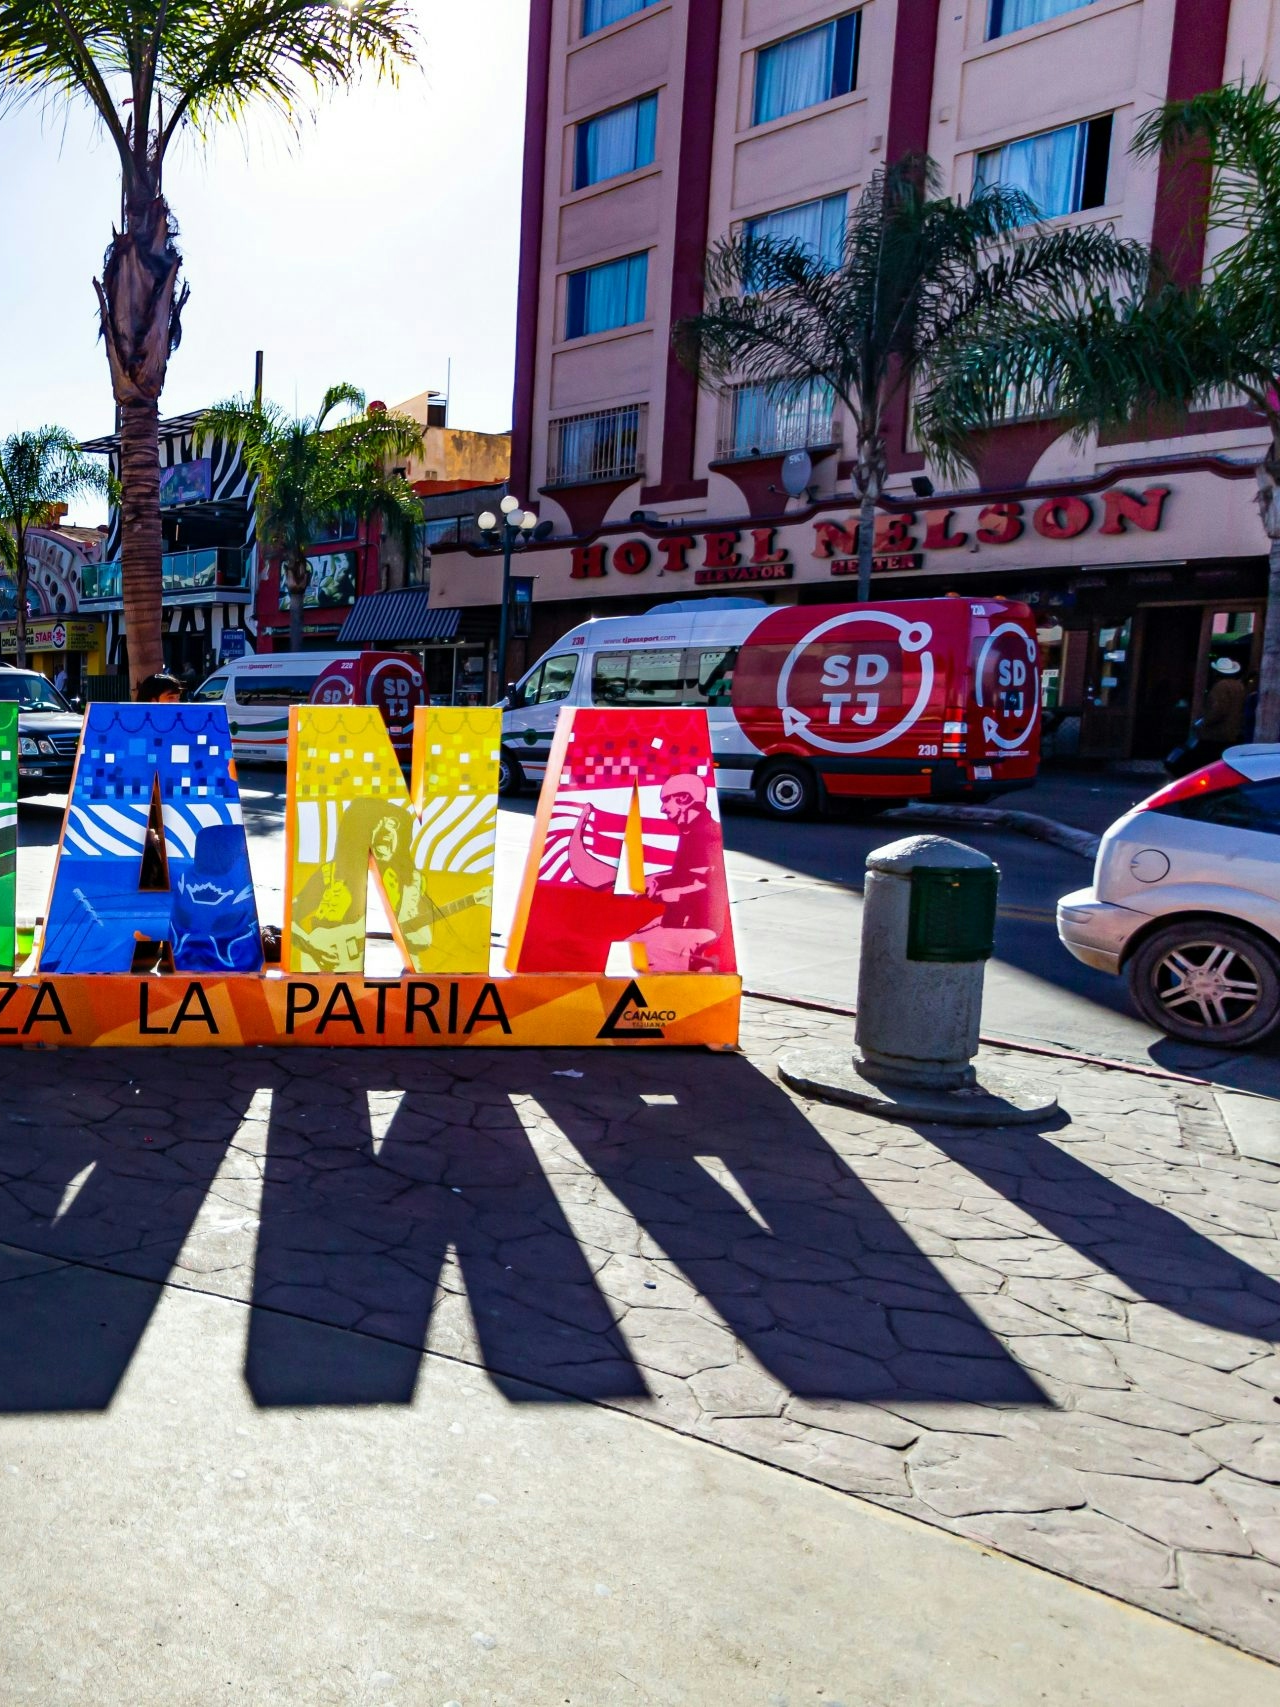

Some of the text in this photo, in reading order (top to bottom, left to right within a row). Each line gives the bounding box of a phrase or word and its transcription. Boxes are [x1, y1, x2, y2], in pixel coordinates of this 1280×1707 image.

[570, 488, 1169, 579] HOTEL NELSON
[697, 564, 786, 583] ELEVATOR
[833, 555, 915, 574] HETER
[35, 632, 52, 643] STAR
[571, 636, 585, 646] 230
[820, 654, 889, 687] SD
[998, 659, 1026, 687] SD
[384, 678, 411, 696] SD
[323, 690, 342, 704] SD
[386, 699, 409, 718] TJ
[823, 693, 880, 726] TJ
[918, 744, 939, 756] 230
[138, 981, 220, 1035] LA
[284, 981, 513, 1035] PATRIA
[623, 1010, 677, 1022] CANACO
